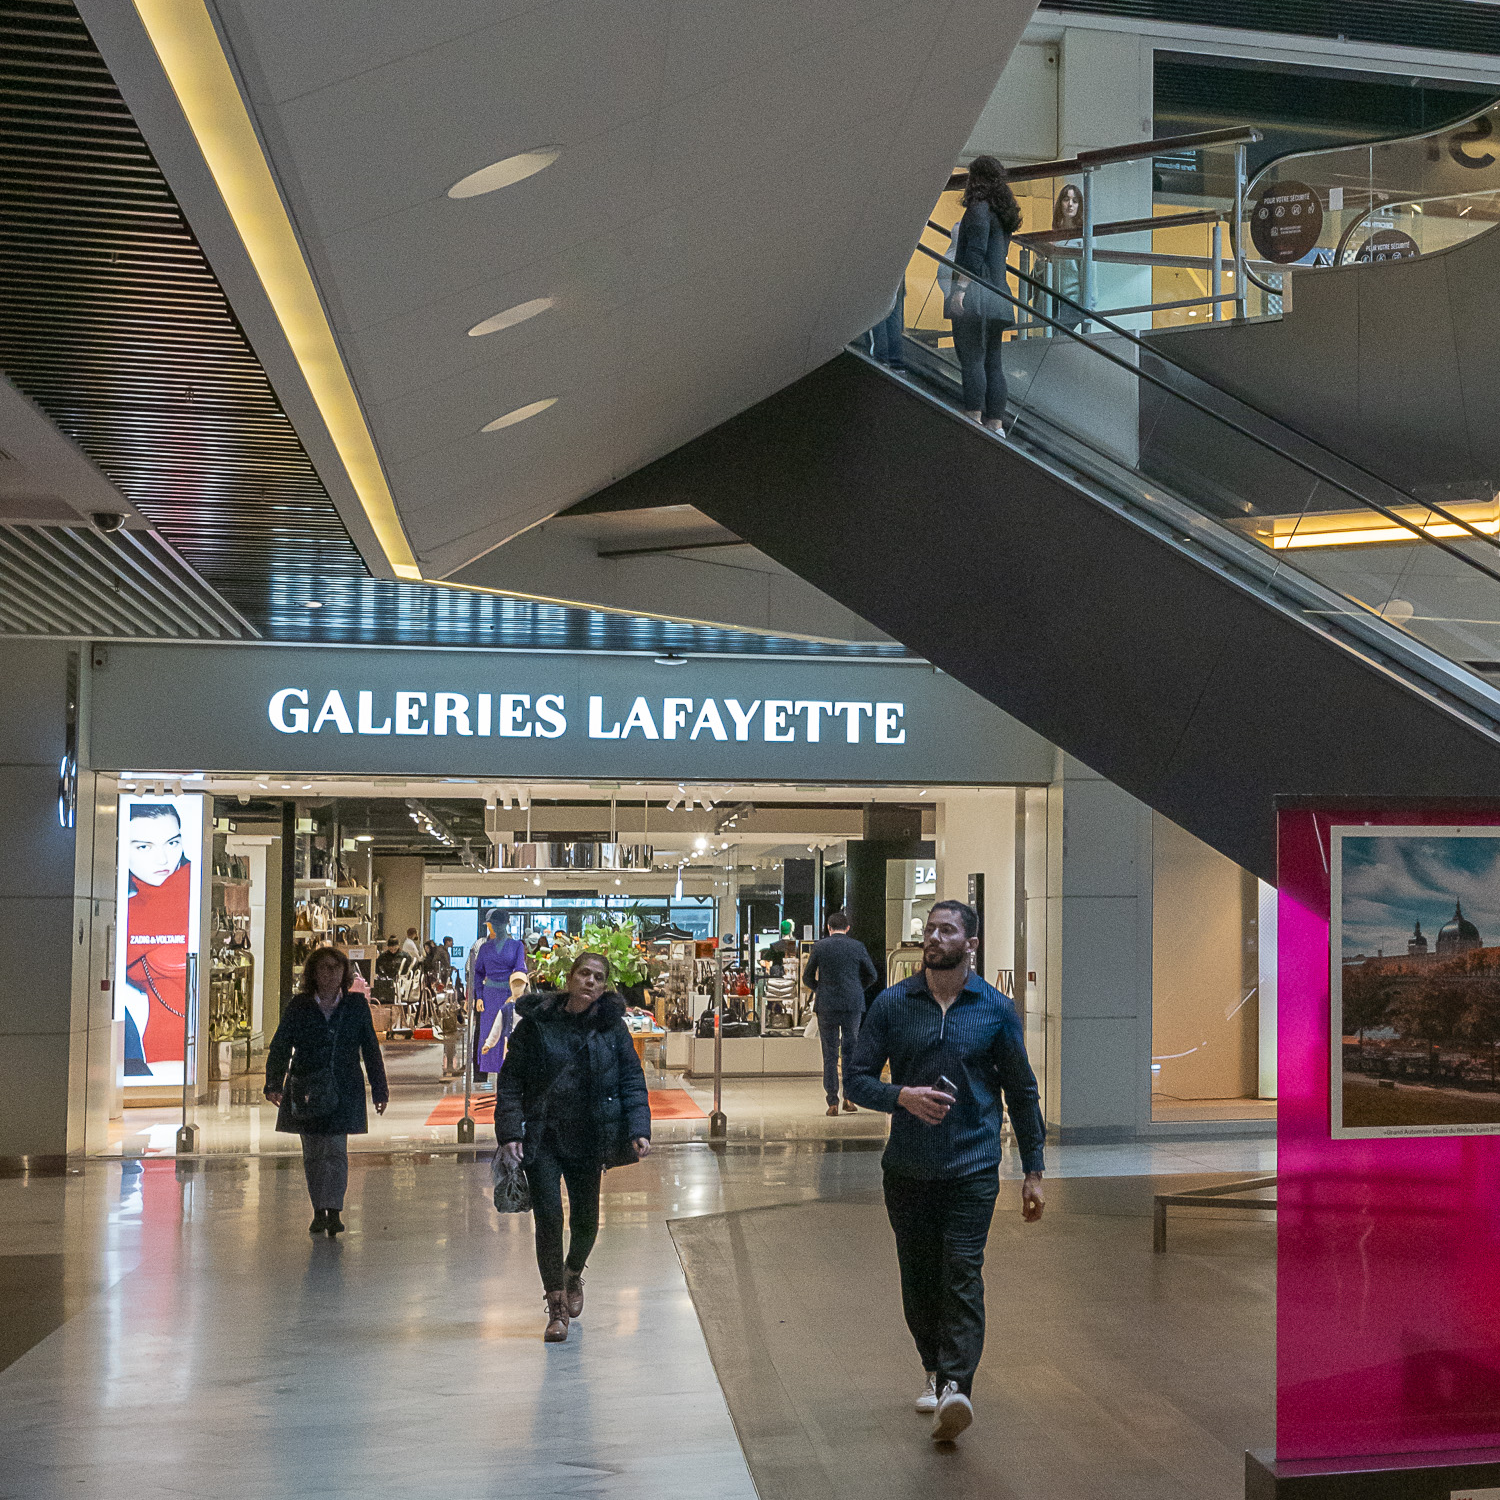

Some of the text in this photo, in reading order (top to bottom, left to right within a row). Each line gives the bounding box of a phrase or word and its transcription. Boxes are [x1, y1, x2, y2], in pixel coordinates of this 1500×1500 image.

[1276, 195, 1289, 203] VOTRE
[268, 688, 906, 744] GALERIES LAFAYETTE
